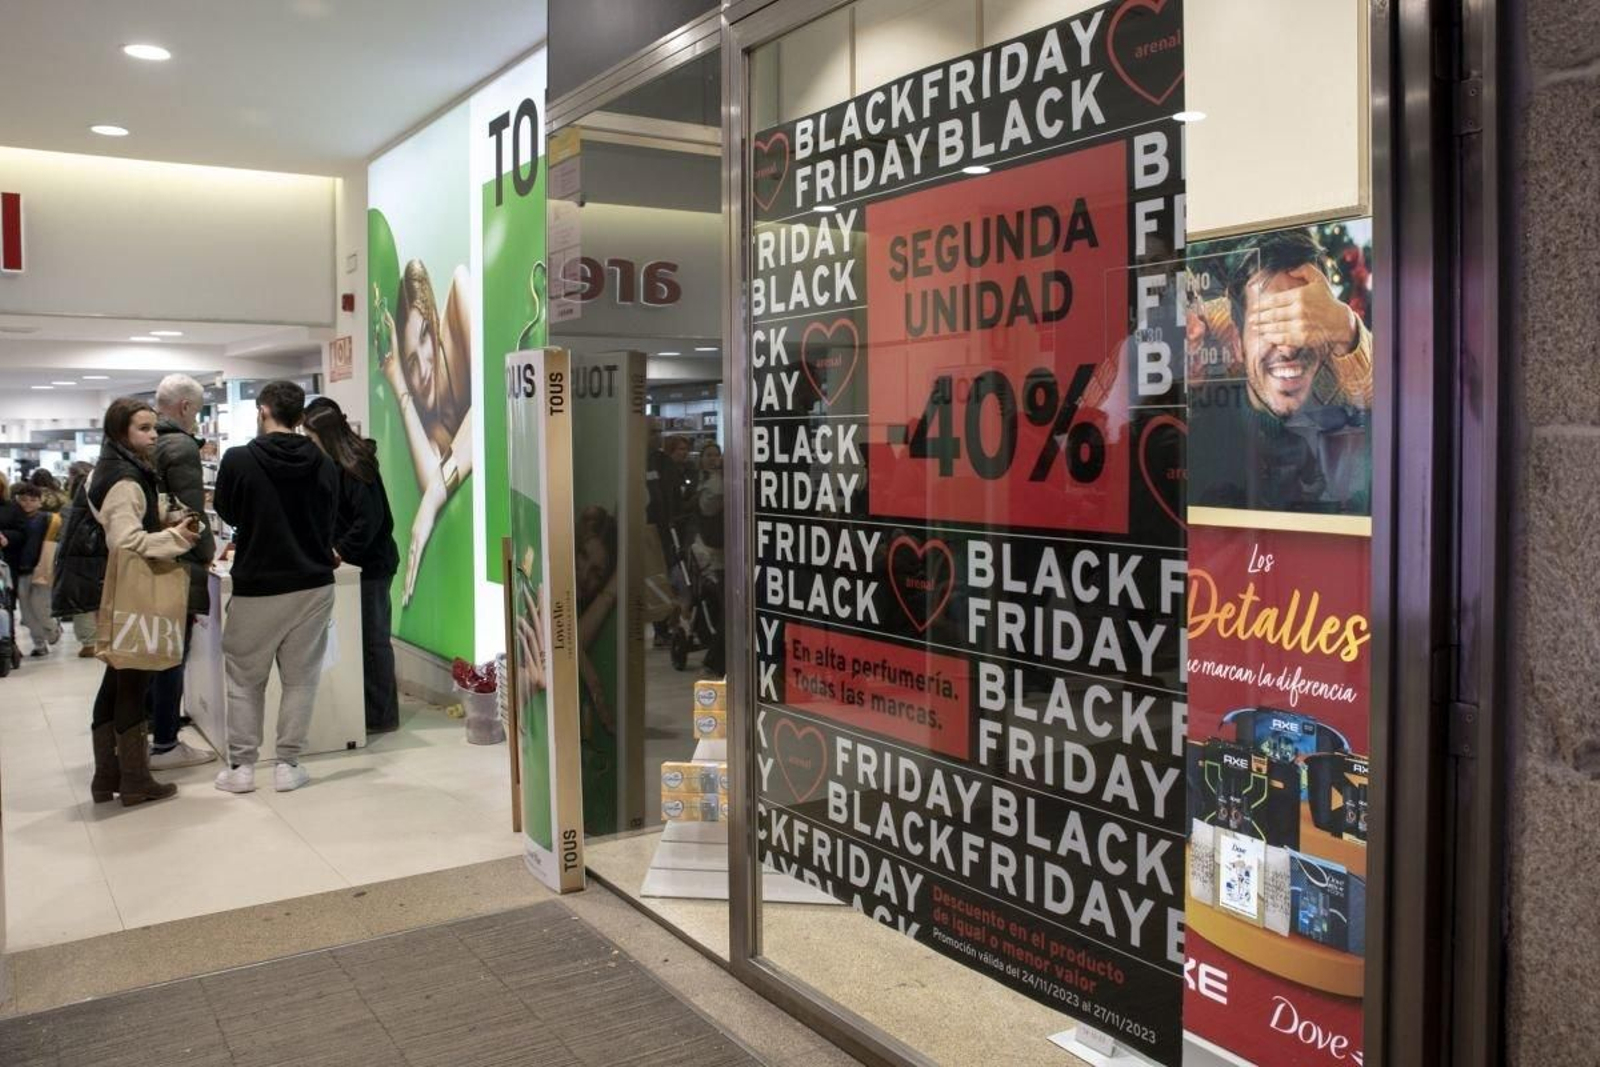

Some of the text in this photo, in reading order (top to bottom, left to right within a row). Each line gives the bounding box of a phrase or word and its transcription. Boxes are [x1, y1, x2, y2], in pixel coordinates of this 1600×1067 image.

[1134, 29, 1181, 58] arenal
[753, 208, 858, 271] RIDAY
[889, 197, 1099, 282] SEGUNDA
[753, 259, 857, 317] BLACK
[905, 270, 1073, 337] UNIDAD
[549, 372, 564, 416] TOUS
[886, 362, 1106, 484] -40%
[753, 424, 860, 465] BLACK
[754, 471, 859, 514] RIDAY
[757, 520, 881, 573] FRIDAY
[967, 539, 1146, 610] BLACK
[1247, 543, 1275, 573] Los
[756, 617, 780, 656] Y
[968, 597, 1167, 677] FRIDAY
[1187, 568, 1371, 663] Detalles
[792, 639, 960, 702] En alta perfumería.
[792, 668, 943, 731] Todas las marcas.
[1202, 660, 1257, 685] marcan
[1258, 663, 1275, 687] la
[1276, 666, 1357, 707] diferencia
[978, 661, 1158, 751] BLACK
[1271, 718, 1299, 733] AXE
[979, 718, 1181, 819] FRIDAY
[1223, 754, 1249, 770] AXE
[563, 829, 577, 872] TOUS
[932, 885, 1126, 985] Descuento en el producto
[932, 907, 1097, 995] de igual o menor valor
[932, 927, 977, 959] Promoción
[1005, 963, 1021, 979] del
[1021, 970, 1080, 1007] 24/11/2023
[1081, 999, 1092, 1013] al
[1092, 1005, 1157, 1044] 27/11/2023
[1269, 995, 1349, 1060] Dove
